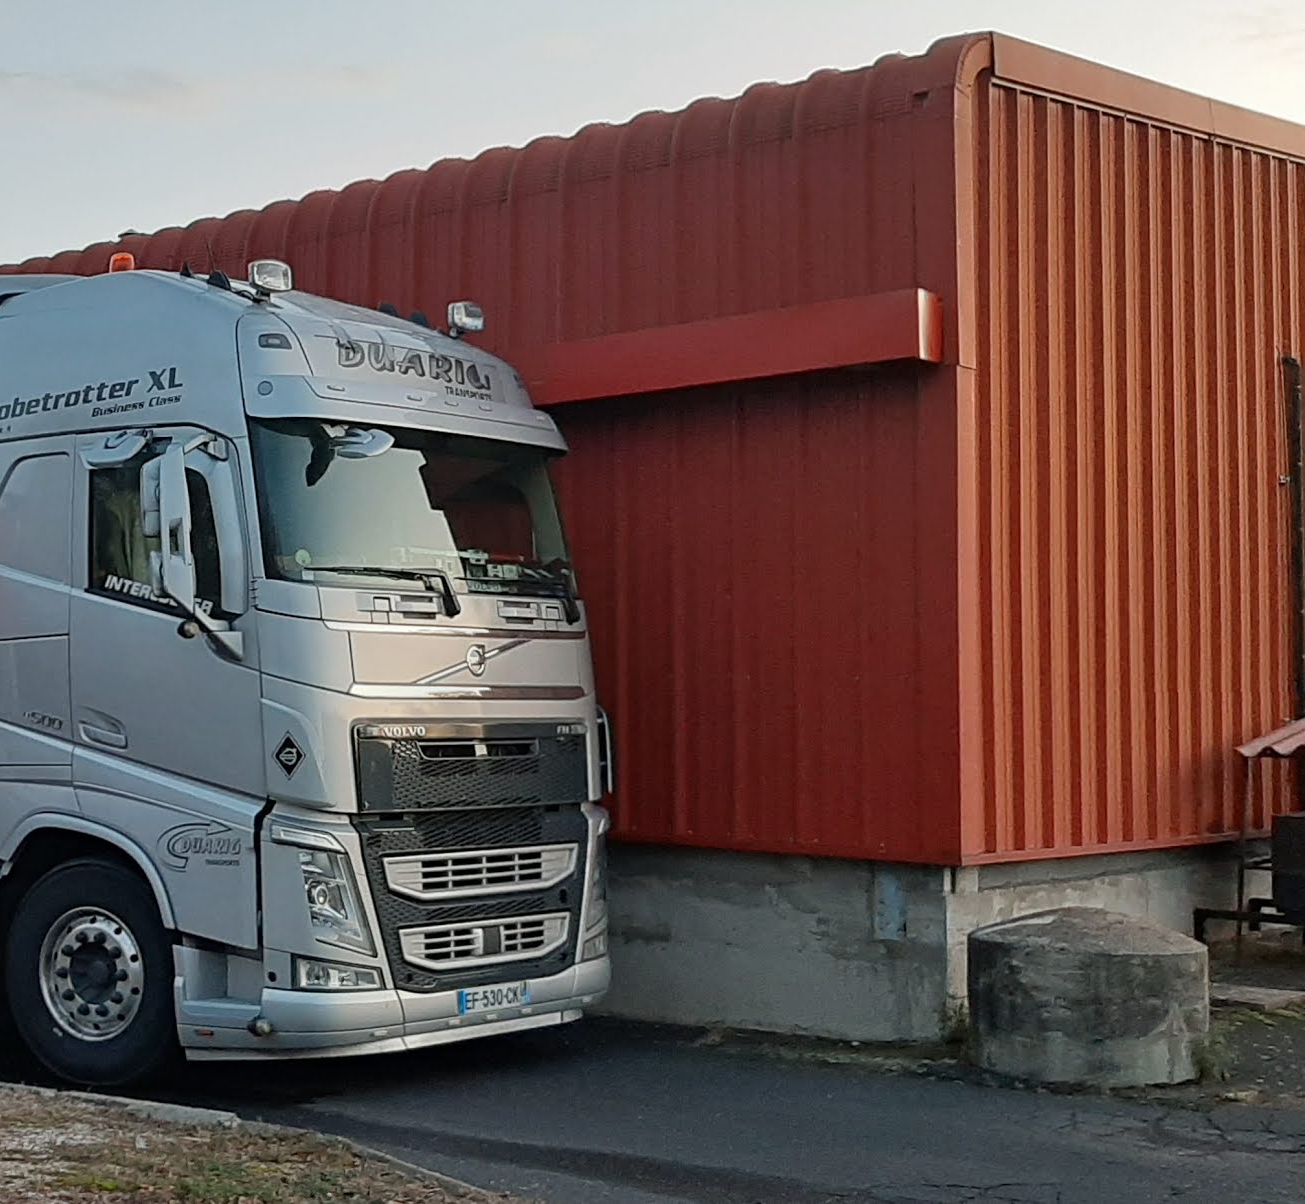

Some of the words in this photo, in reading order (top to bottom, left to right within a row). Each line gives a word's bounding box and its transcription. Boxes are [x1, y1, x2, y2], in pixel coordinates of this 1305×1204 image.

[337, 339, 491, 391] DUARIG
[146, 367, 184, 394] XL
[91, 400, 145, 418] Business
[148, 394, 183, 408] Class
[381, 726, 426, 737] VOLVO
[178, 836, 241, 855] DUARIG
